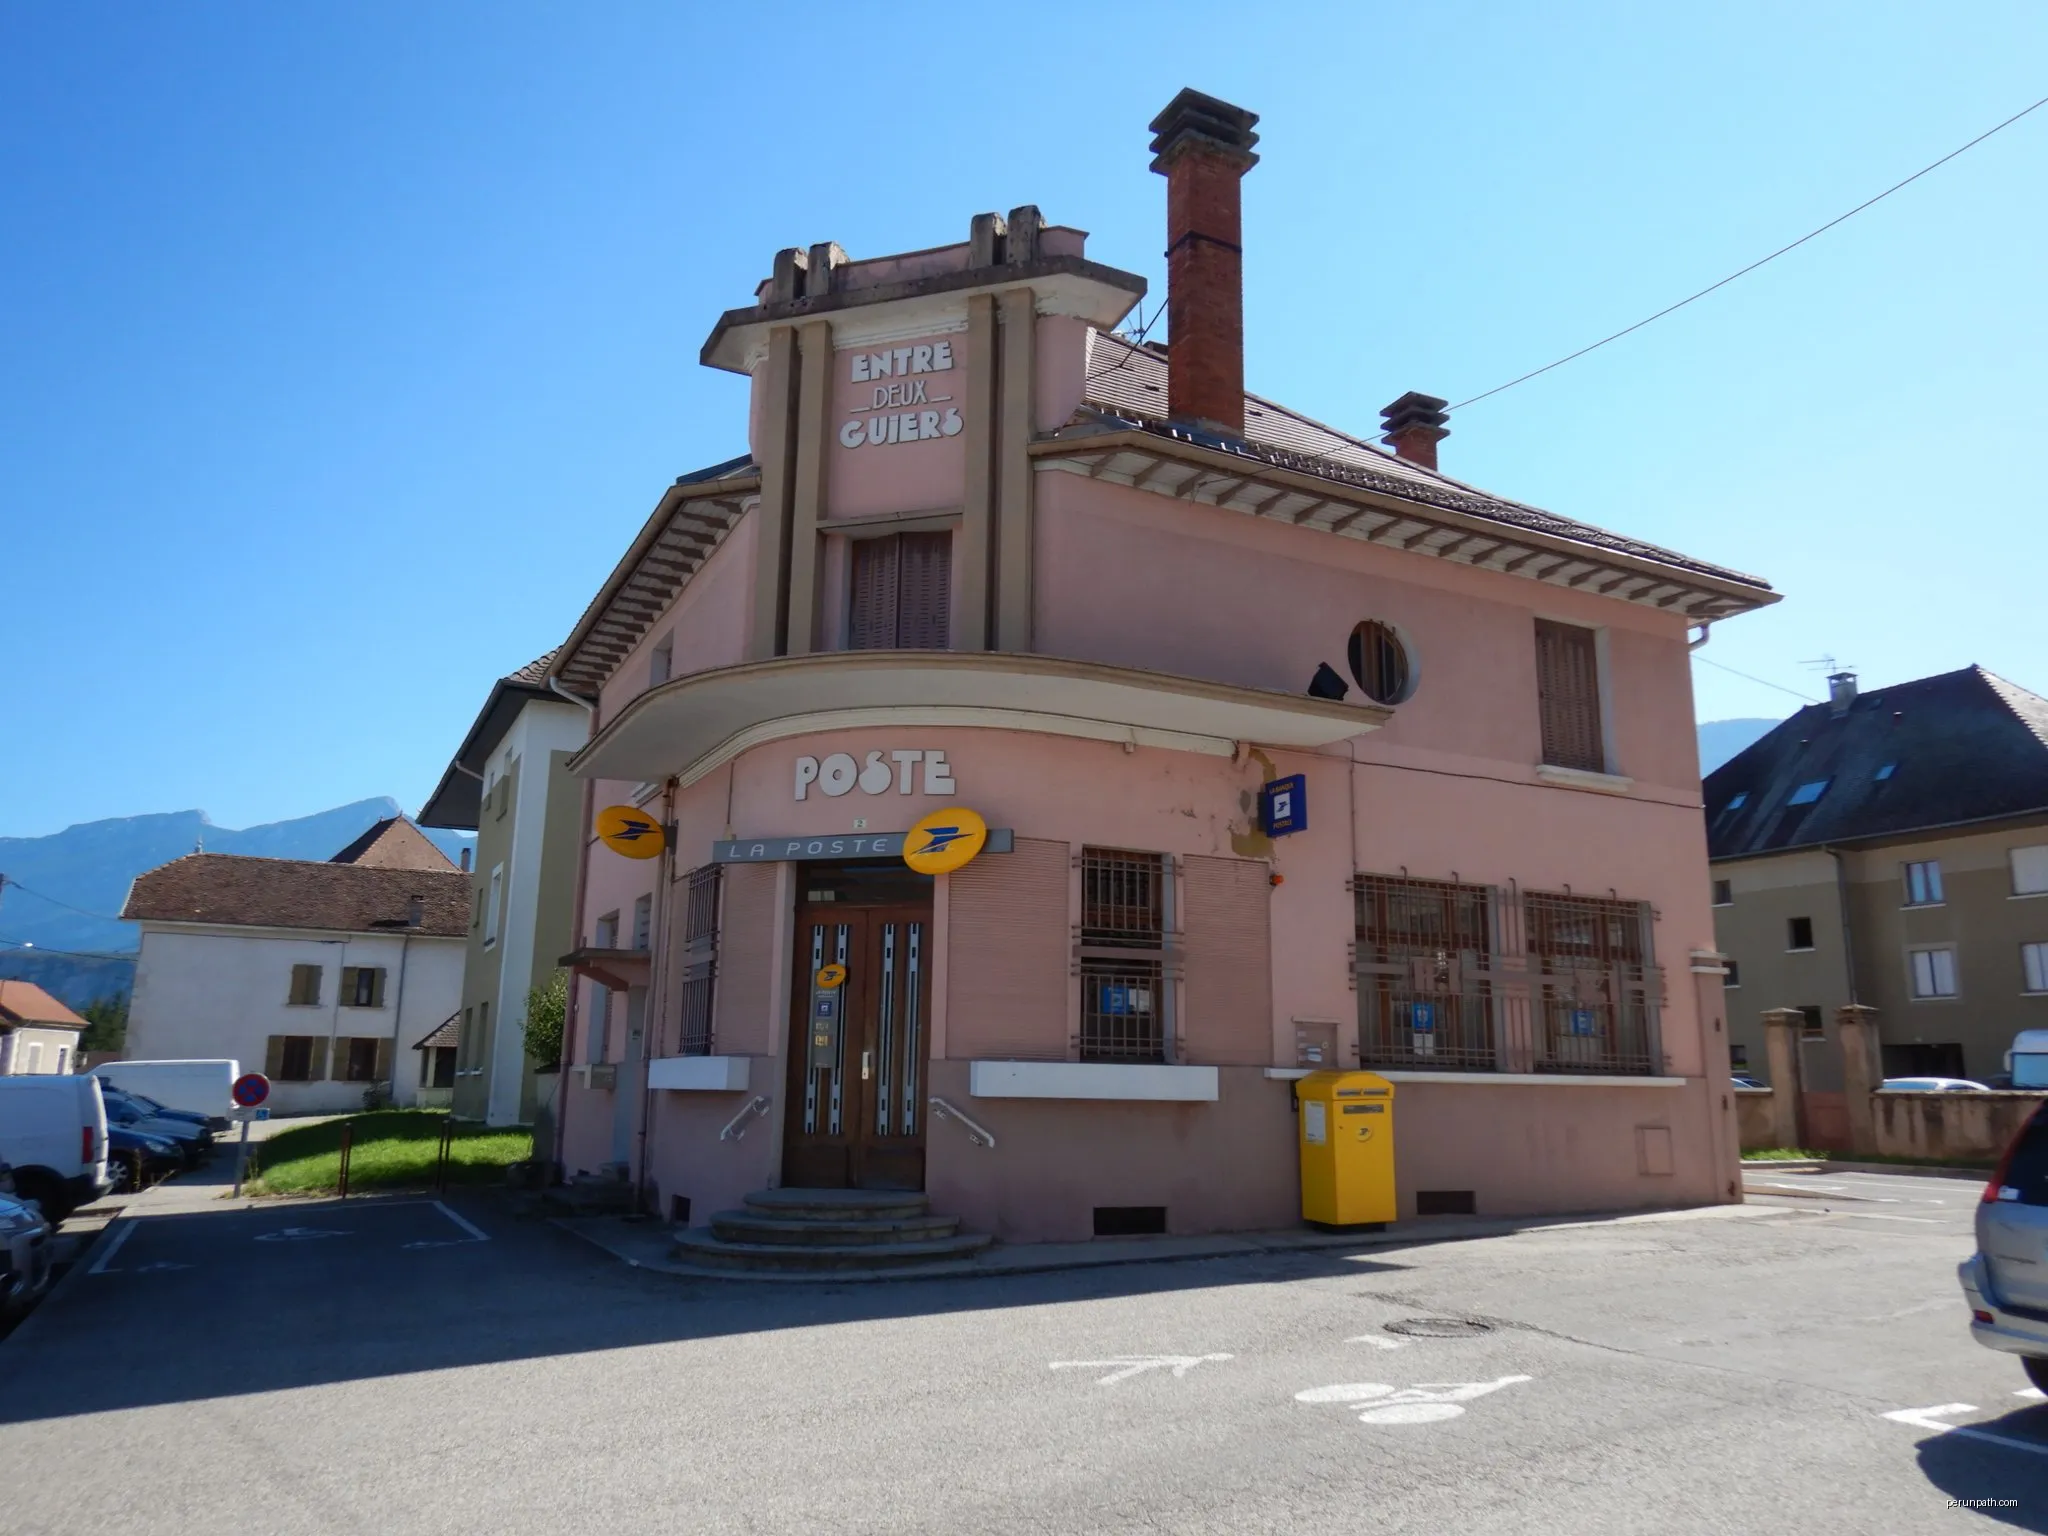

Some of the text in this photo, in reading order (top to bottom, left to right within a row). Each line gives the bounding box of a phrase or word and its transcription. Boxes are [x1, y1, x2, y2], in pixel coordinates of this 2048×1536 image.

[851, 340, 953, 383] ENTRE
[872, 379, 928, 410] DEUX
[839, 407, 965, 449] GUIERS
[794, 749, 956, 801] POSTE
[857, 819, 863, 828] 2
[729, 838, 889, 858] LA POSTE
